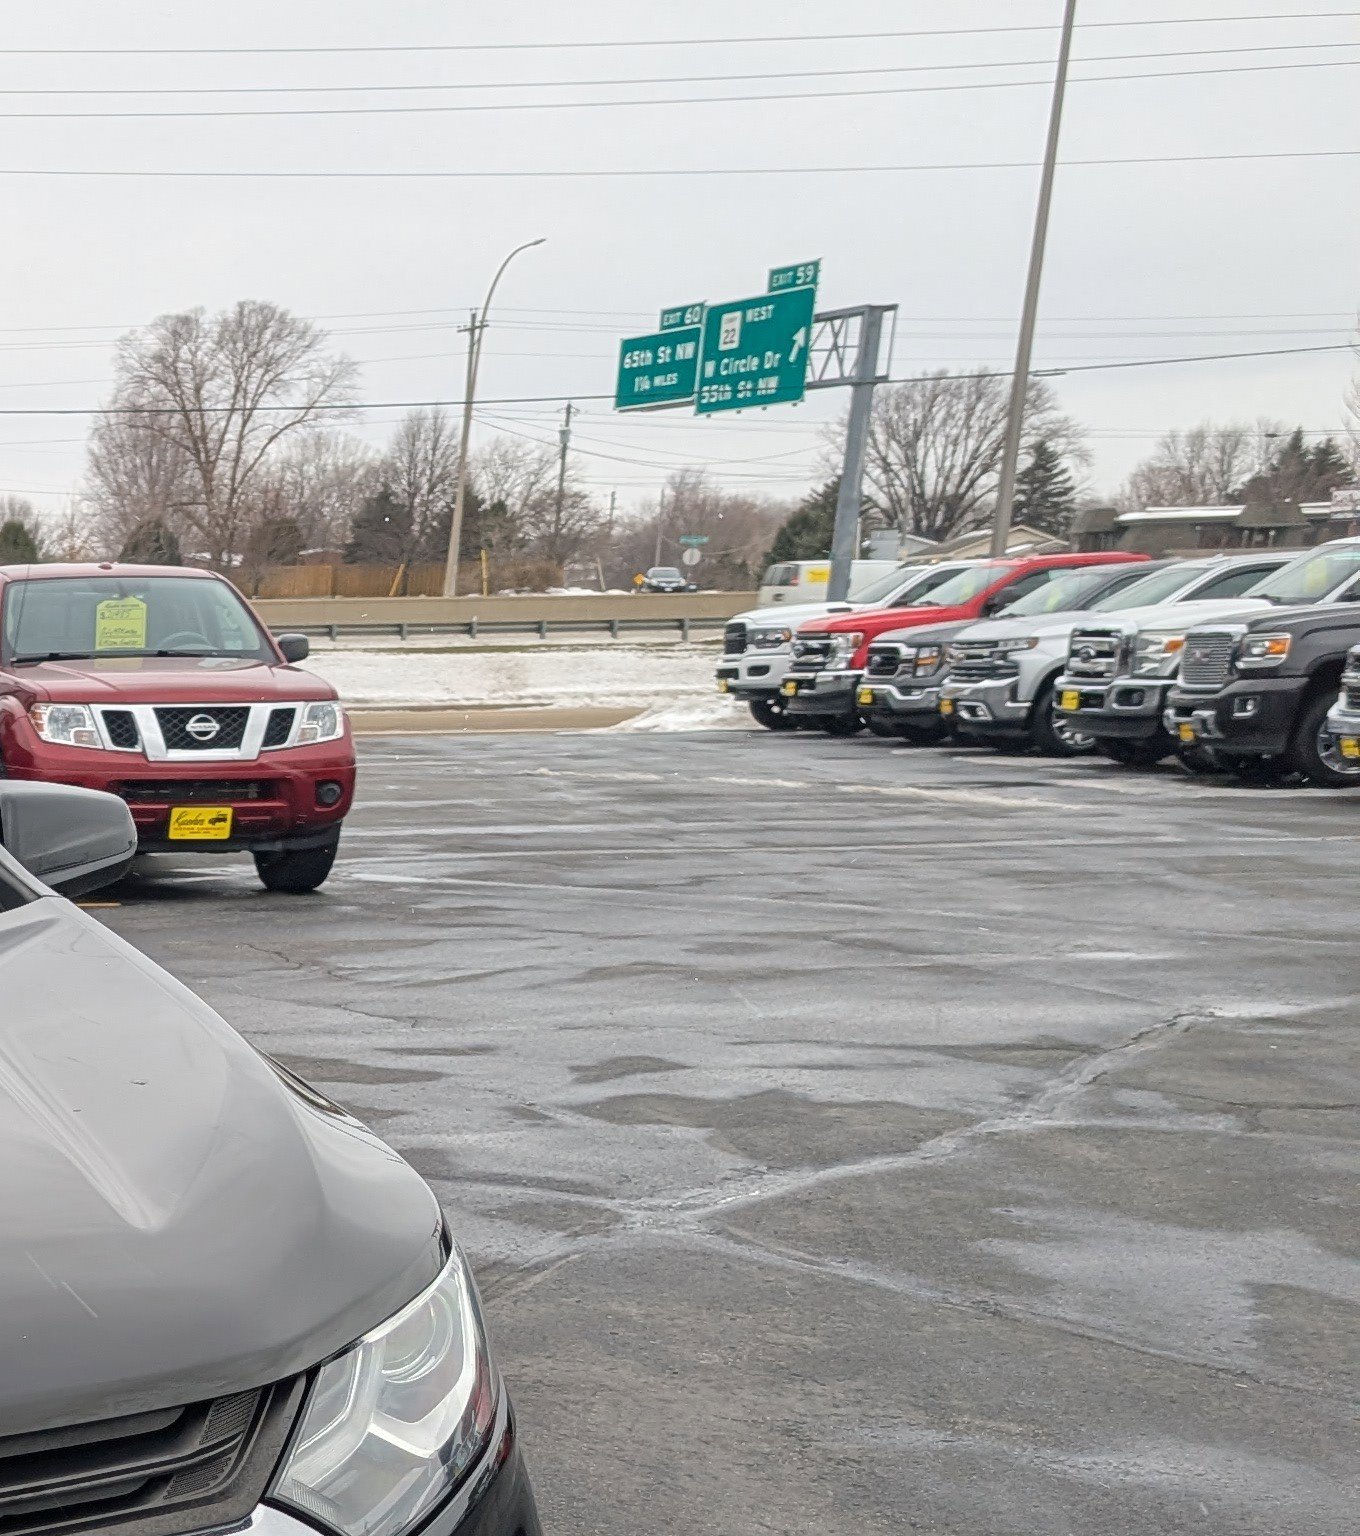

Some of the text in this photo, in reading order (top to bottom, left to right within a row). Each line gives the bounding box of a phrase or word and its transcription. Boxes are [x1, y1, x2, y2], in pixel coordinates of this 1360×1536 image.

[772, 264, 814, 287] EXIT 59
[684, 306, 701, 325] 60
[746, 304, 775, 323] WEST
[723, 328, 736, 345] 22
[623, 341, 695, 369] 65th St NW
[720, 354, 760, 376] Circle
[764, 350, 782, 369] Dr
[653, 372, 679, 387] MILES
[700, 384, 732, 404] 55th
[736, 380, 753, 399] St
